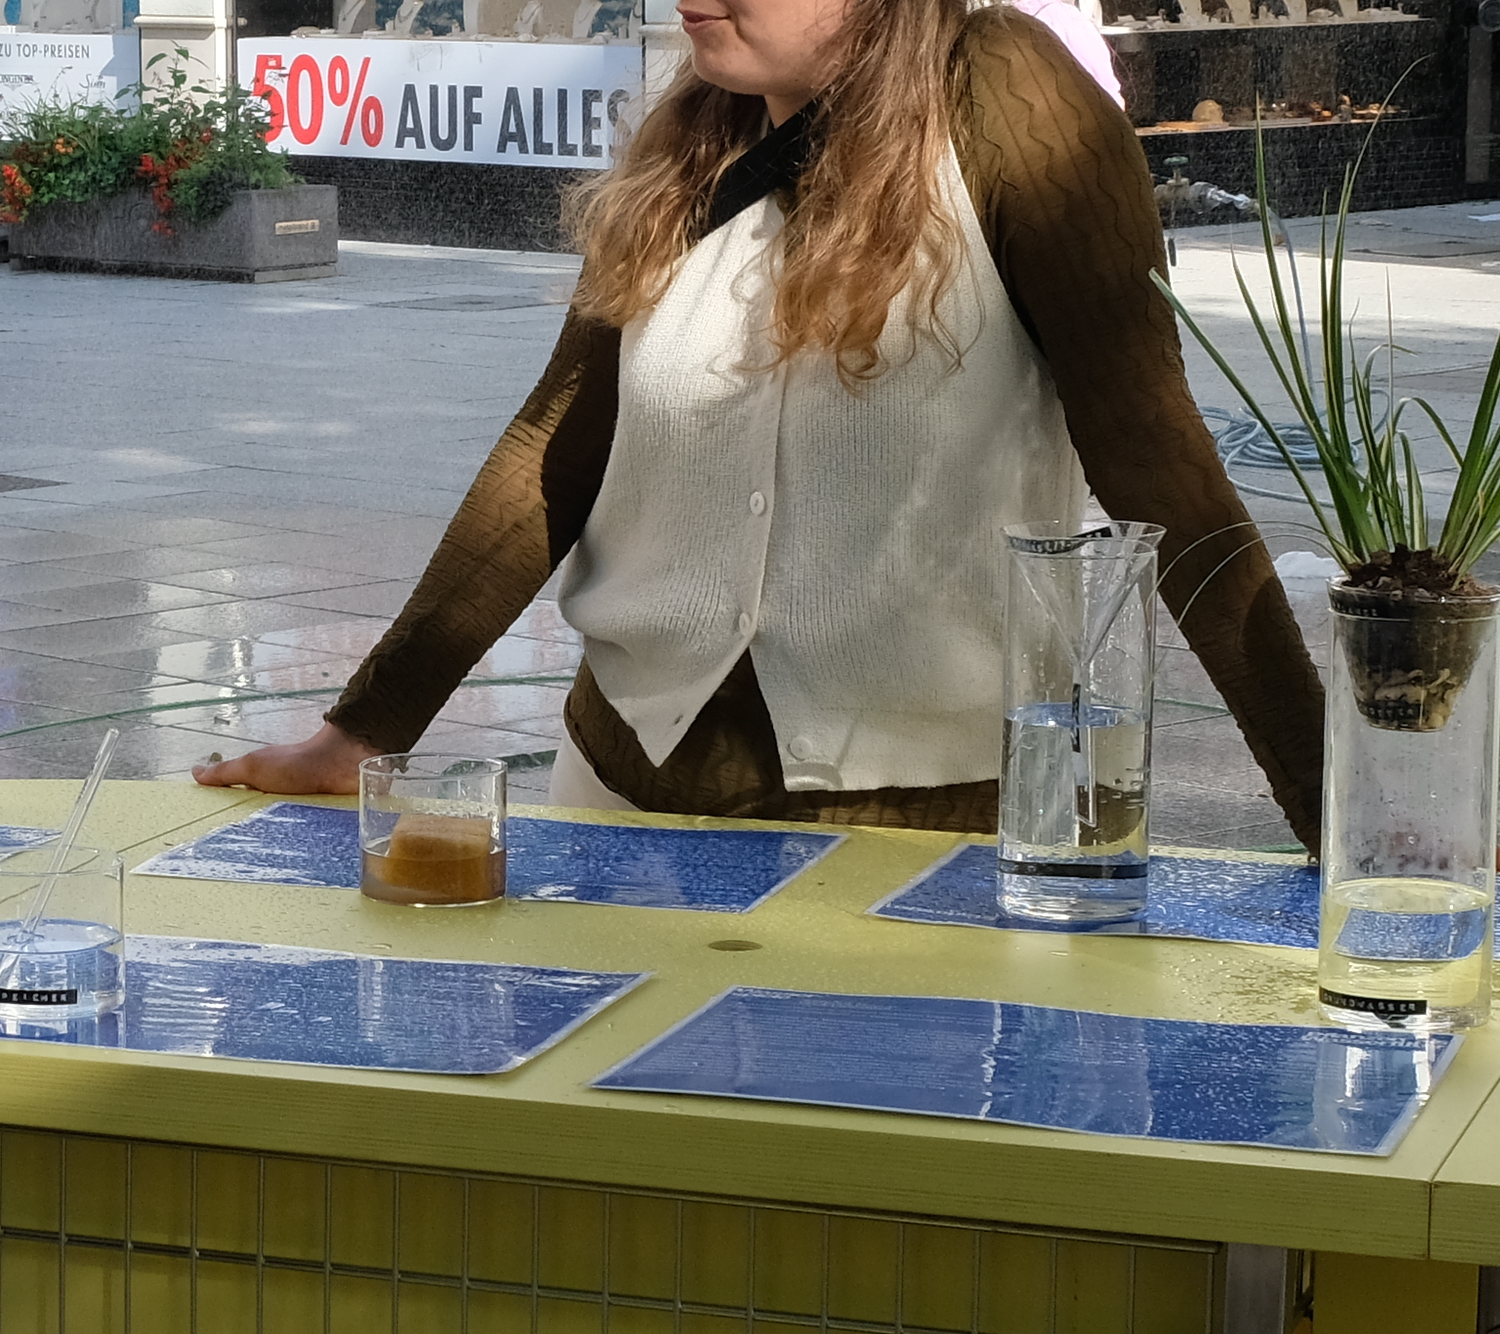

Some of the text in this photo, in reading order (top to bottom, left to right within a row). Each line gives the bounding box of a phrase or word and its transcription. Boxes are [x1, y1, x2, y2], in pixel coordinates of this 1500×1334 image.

[16, 43, 90, 59] TOP-PREISEN
[254, 54, 384, 149] 50%
[394, 83, 485, 152] AUF
